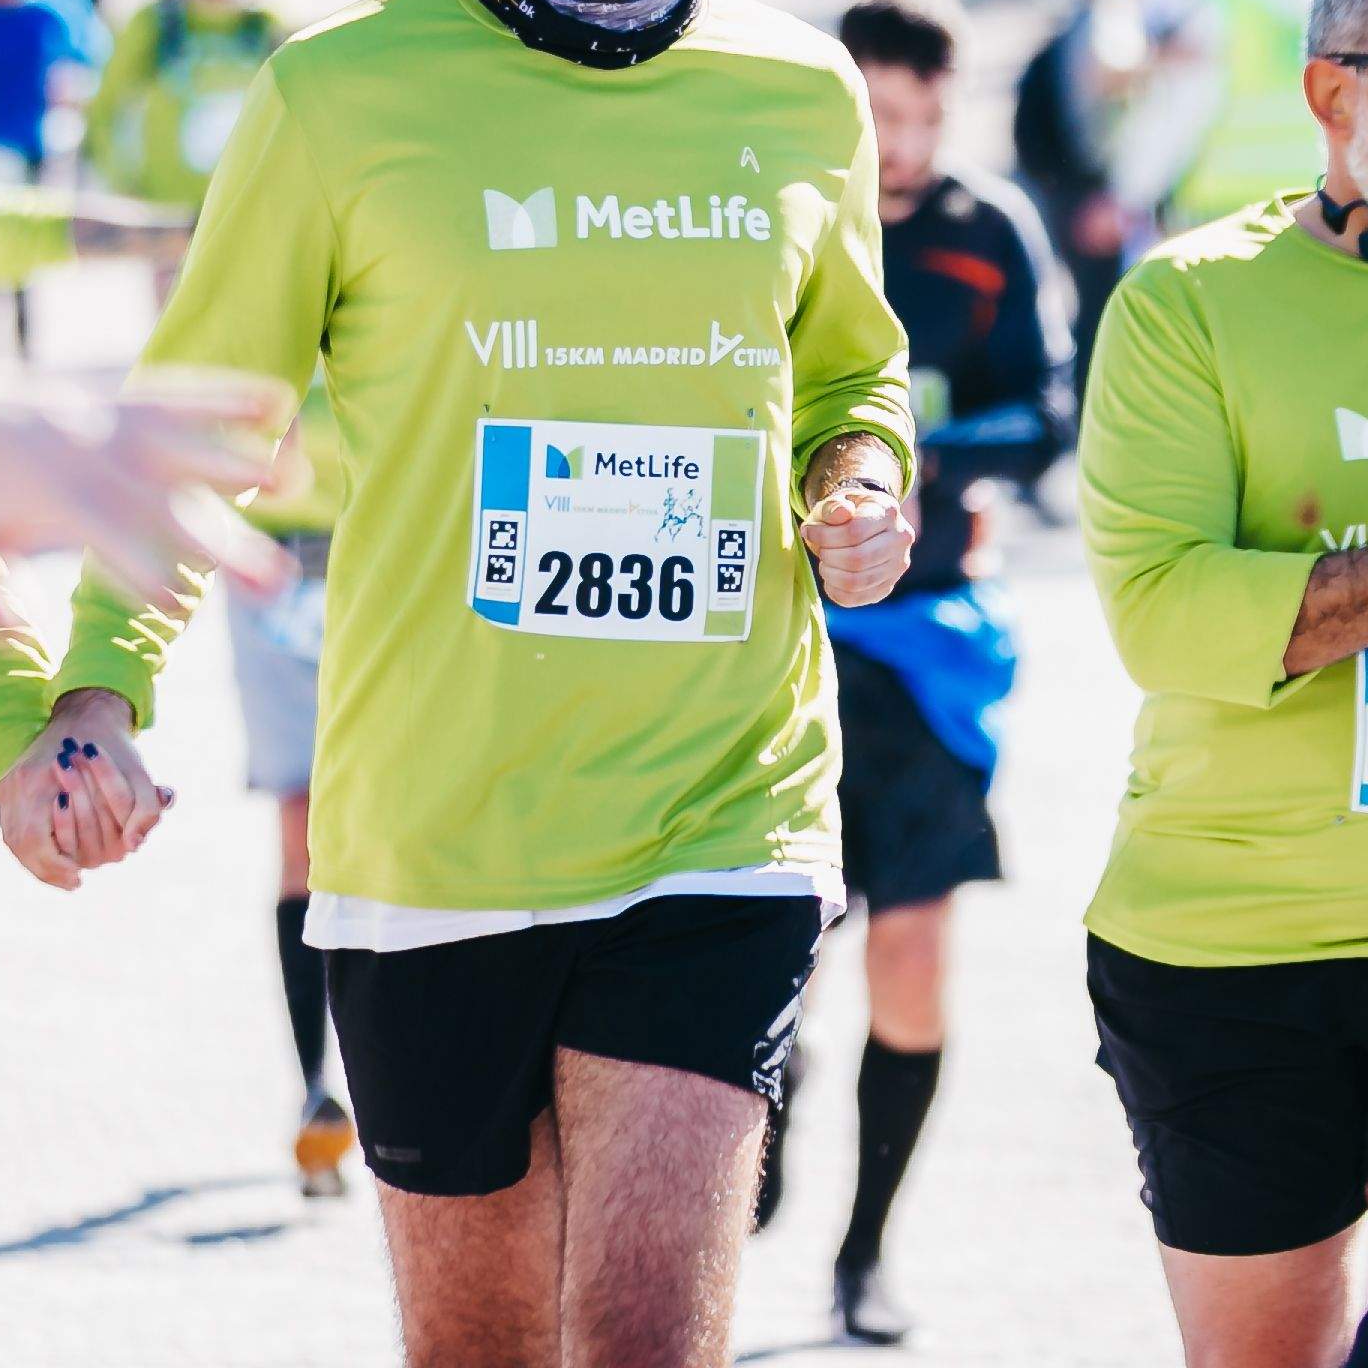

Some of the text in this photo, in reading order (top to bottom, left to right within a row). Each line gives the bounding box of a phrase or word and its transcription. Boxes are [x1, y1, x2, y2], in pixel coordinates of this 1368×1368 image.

[576, 195, 771, 241] MetLife
[465, 319, 538, 369] VIII
[545, 347, 605, 365] 15KM
[594, 452, 700, 480] MetLife
[534, 550, 695, 622] 2836
